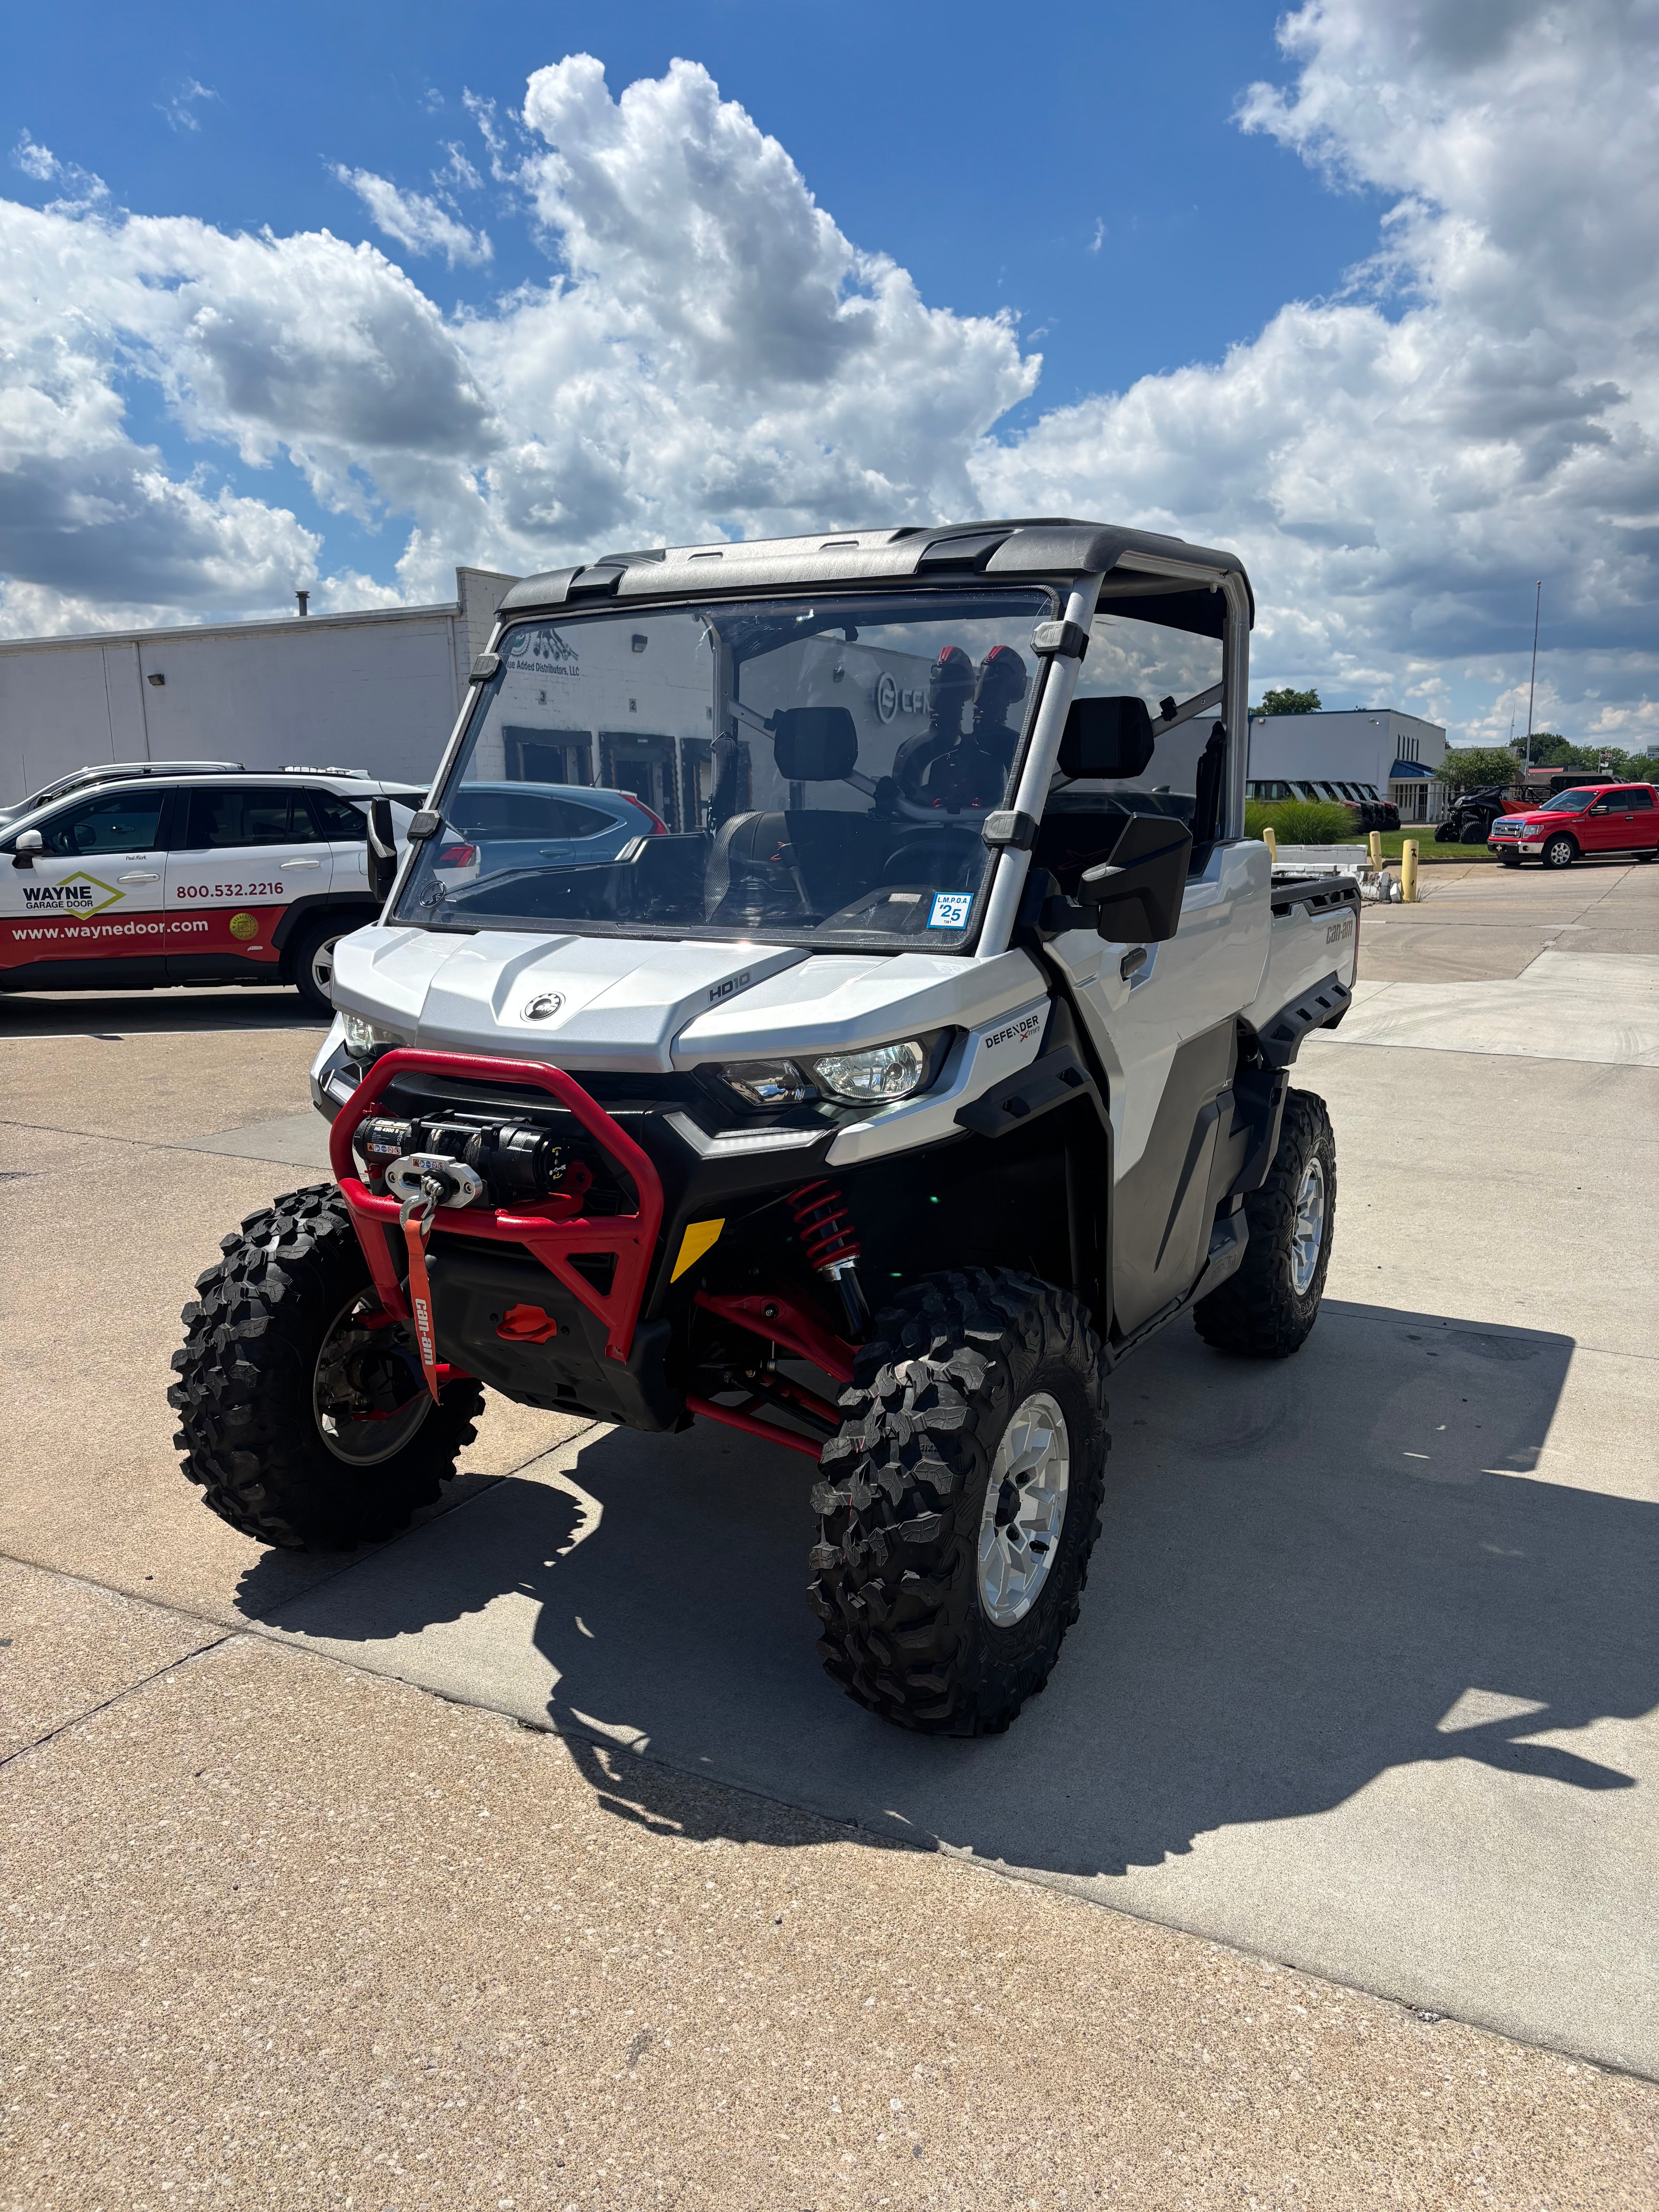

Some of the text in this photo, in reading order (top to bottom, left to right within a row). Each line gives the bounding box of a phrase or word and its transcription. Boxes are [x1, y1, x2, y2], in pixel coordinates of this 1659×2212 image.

[517, 659, 534, 671] Added
[536, 663, 568, 677] Distributors,
[569, 665, 579, 676] LLC
[540, 692, 545, 702] 3
[630, 701, 635, 710] 2
[22, 886, 92, 901] WAYNE
[177, 882, 284, 898] 800.532.2216
[939, 904, 962, 921] '25
[12, 921, 208, 940] www.waynedoor.com
[1326, 919, 1353, 945] can-am
[709, 972, 750, 1002] HD10
[986, 1015, 1039, 1049] DEFENDER
[415, 1298, 433, 1365] can-am
